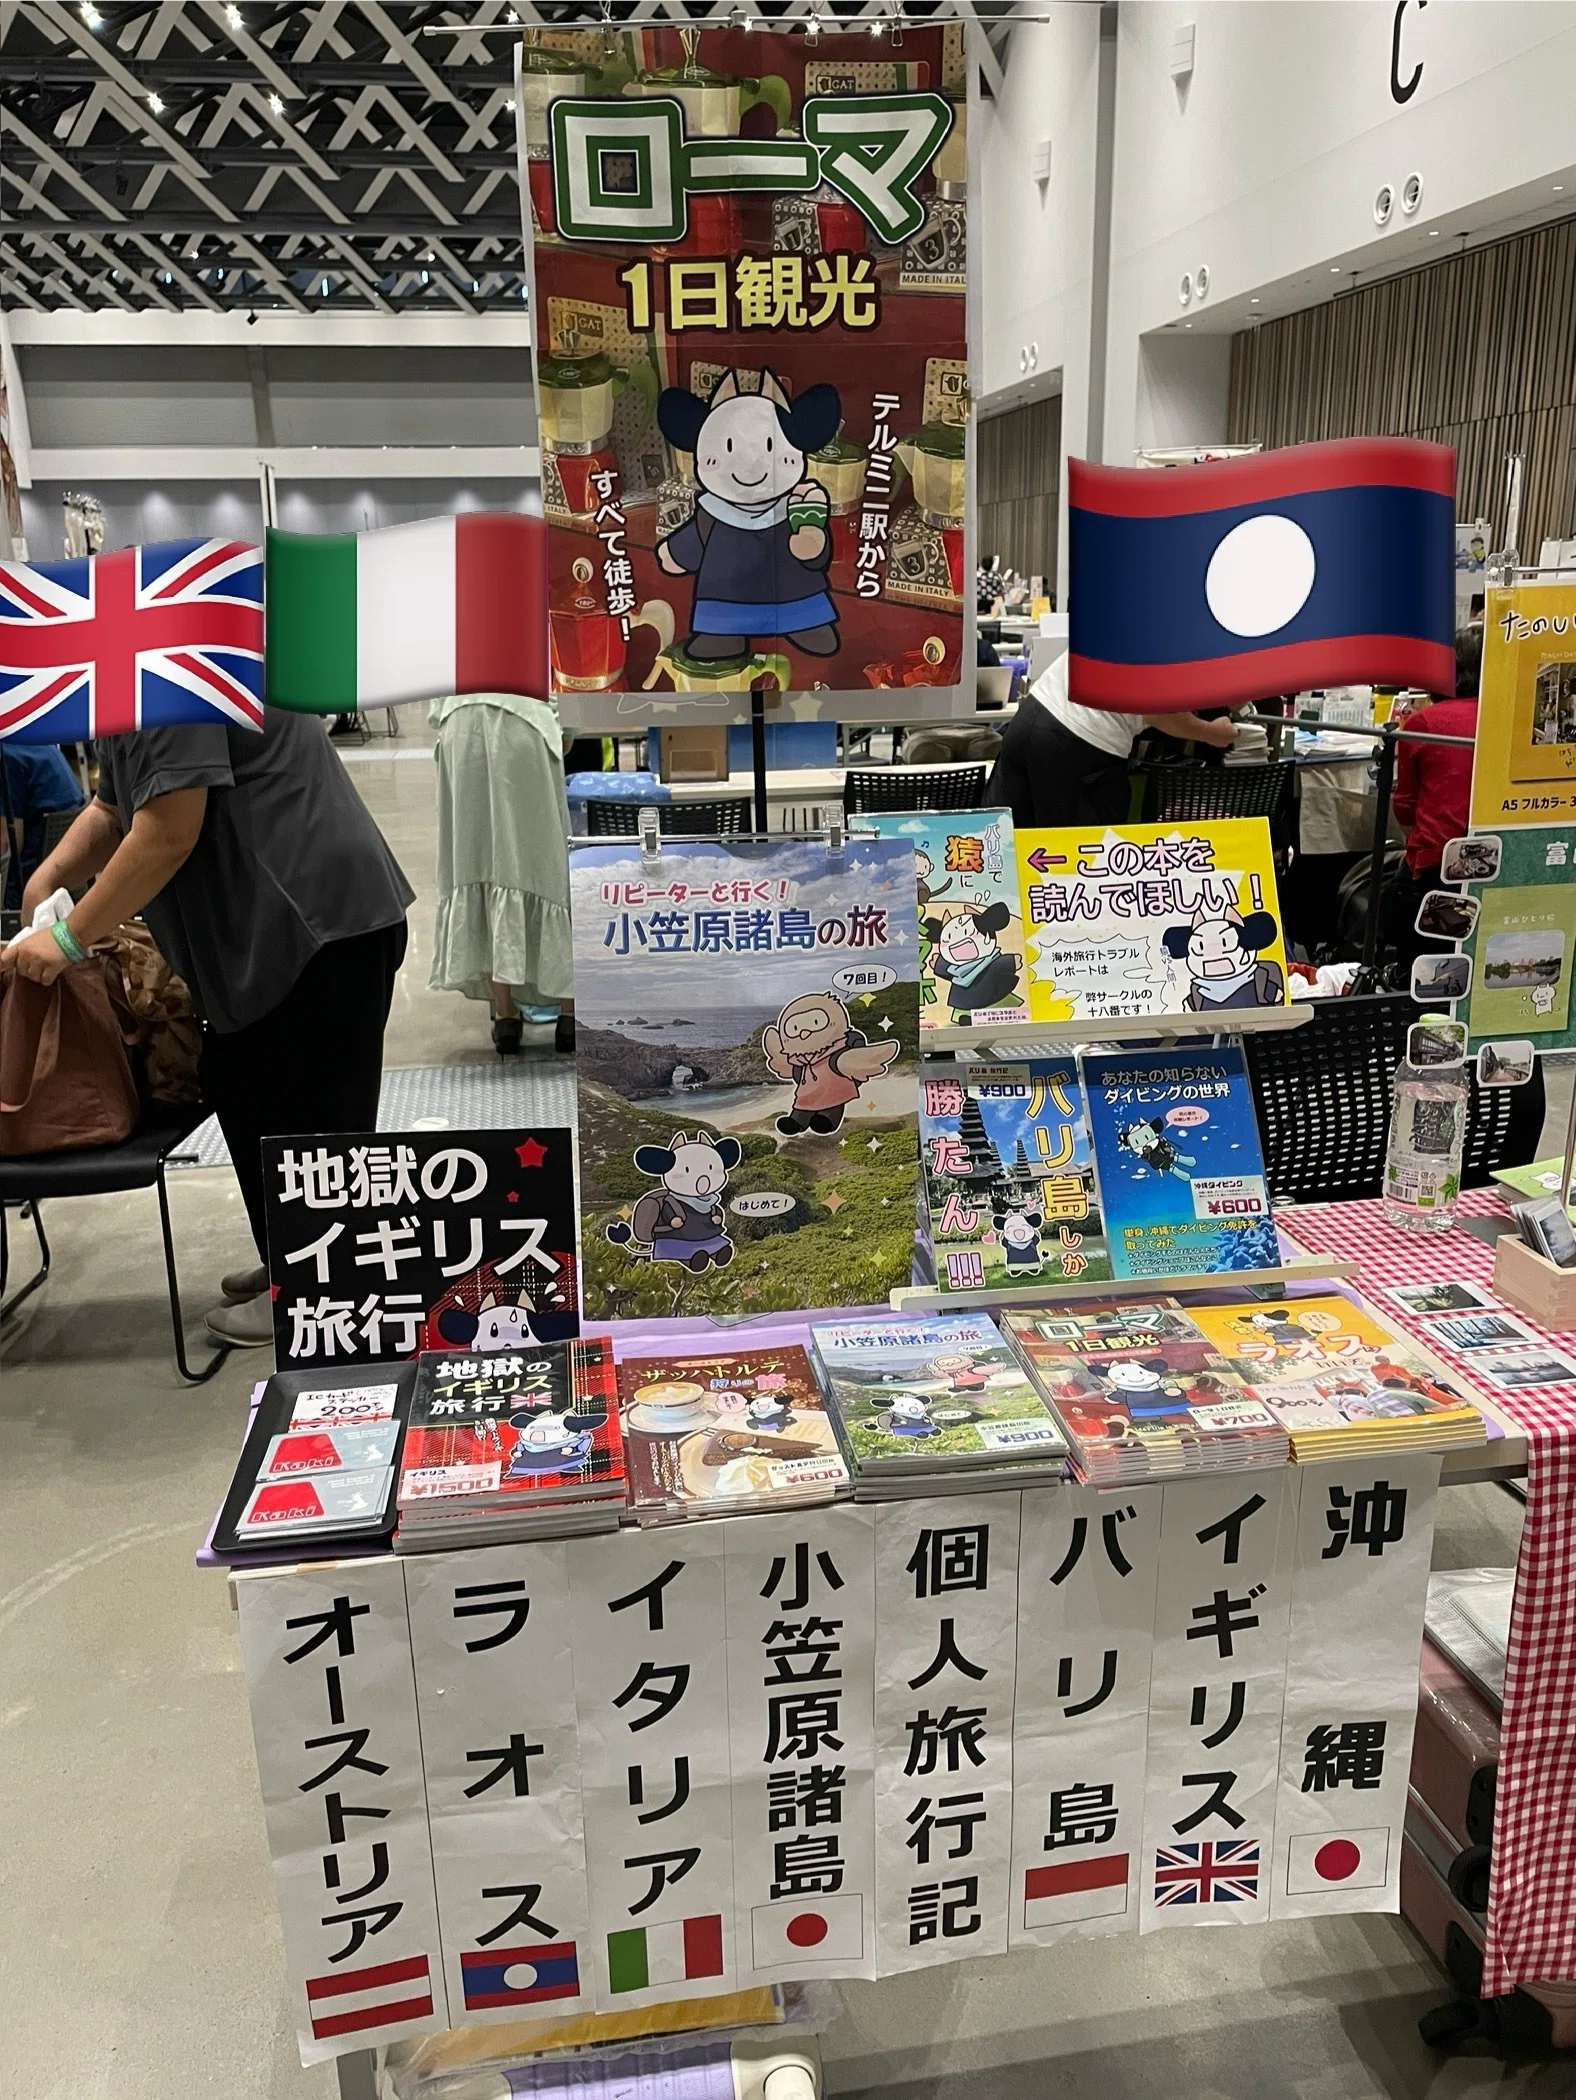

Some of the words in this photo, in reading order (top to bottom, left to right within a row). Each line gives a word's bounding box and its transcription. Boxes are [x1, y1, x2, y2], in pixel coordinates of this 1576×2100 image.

[556, 96, 950, 241] ローマ
[902, 274, 930, 285] MADE
[932, 274, 942, 285] IN
[621, 256, 876, 330] 1日観光
[856, 393, 900, 598] テルミニ駅から
[590, 470, 636, 641] すべて徒歩！
[888, 580, 912, 592] MADE
[914, 586, 925, 595] IN
[926, 587, 950, 598] ITALY
[1500, 611, 1576, 643] たのし
[1502, 799, 1518, 811] A5
[1522, 796, 1566, 810] フルカラー
[985, 824, 1004, 883] バリ島で
[1077, 838, 1215, 879] この本を
[1546, 841, 1576, 866] 富
[603, 880, 788, 904] リピーターと行く！
[1030, 873, 1265, 923] 読んでほしい！
[603, 904, 888, 955] 小笠原諸島の旅
[1052, 947, 1140, 963] 海外旅行トラブル
[1054, 965, 1108, 977] レポートは
[1086, 989, 1153, 1003] 弊サークルの
[1088, 1004, 1151, 1017] 十八番です！
[1101, 1065, 1227, 1087] あなたの知らない
[978, 1083, 1026, 1098] ¥900
[1103, 1082, 1231, 1105] ダイビングの世界
[277, 1145, 488, 1209] 地獄の
[1026, 1072, 1087, 1278] バリ島しか
[1207, 1197, 1262, 1215] ¥600
[284, 1216, 561, 1284] イギリス
[288, 1294, 427, 1359] 旅行
[1035, 1312, 1166, 1341] ローマ
[834, 1330, 982, 1349] 小笠原諸島の旅
[1065, 1334, 1161, 1352] 1日観光
[435, 1357, 552, 1380] 地獄の
[641, 1360, 785, 1382] ザッハトルテ
[434, 1375, 553, 1398] イギリス
[430, 1395, 506, 1416] 旅行
[1210, 1413, 1269, 1428] ¥700
[996, 1430, 1054, 1444] ¥900
[410, 1477, 494, 1496] ¥1500
[785, 1468, 843, 1484] ¥600
[1300, 1479, 1408, 1794] 沖縄
[1171, 1492, 1267, 1837] イギリス
[1043, 1505, 1137, 1852] バリ島
[759, 1542, 845, 1900] 小笠原諸島
[607, 1559, 702, 1917] イタリア
[904, 1523, 989, 1946] 個人旅行記
[452, 1579, 560, 1947] ラオス
[282, 1595, 404, 1964] オーストリア
